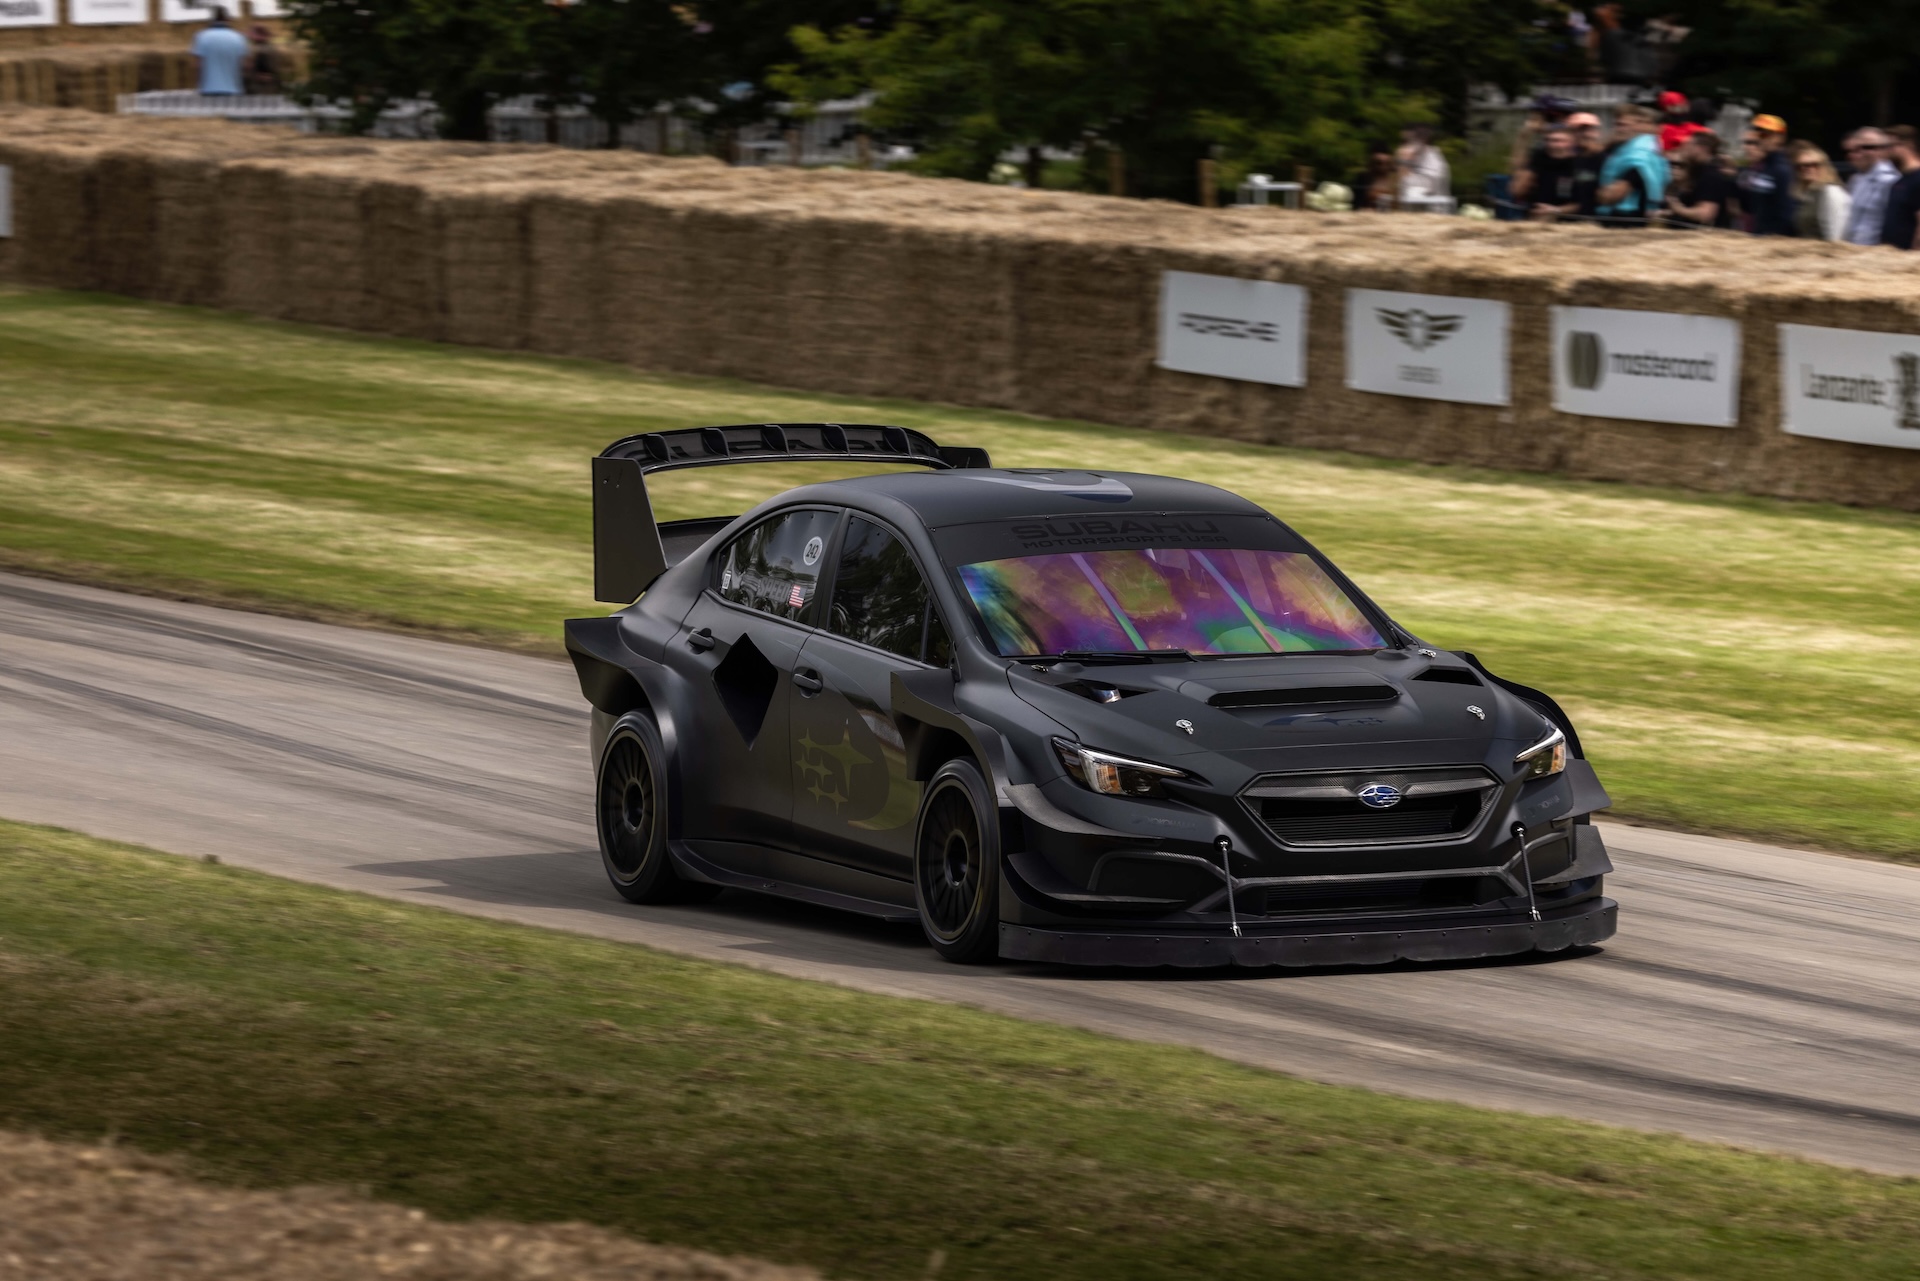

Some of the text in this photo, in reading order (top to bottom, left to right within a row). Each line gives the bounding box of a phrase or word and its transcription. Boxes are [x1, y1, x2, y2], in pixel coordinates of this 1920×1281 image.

[1608, 348, 1719, 382] mastercard
[1011, 519, 1220, 540] SUBARU
[805, 543, 819, 558] 242
[1022, 535, 1229, 549] MOTORSPORTS USA
